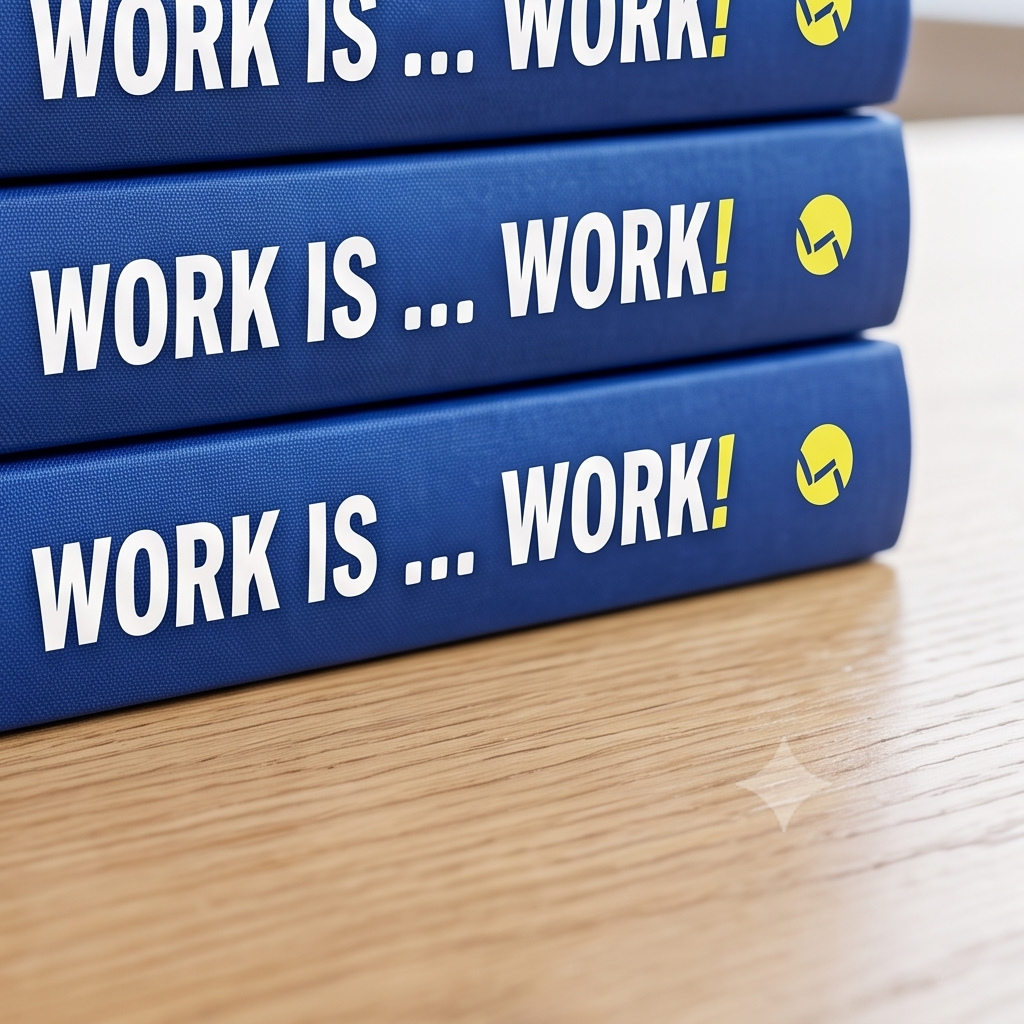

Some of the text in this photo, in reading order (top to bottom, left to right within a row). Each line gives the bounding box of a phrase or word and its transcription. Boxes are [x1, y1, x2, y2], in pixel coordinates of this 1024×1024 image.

[30, 246, 280, 375] WORK
[307, 236, 376, 342] IS
[501, 199, 734, 317] WORK!
[32, 509, 280, 651] WORK
[308, 495, 377, 603] IS
[501, 434, 735, 565] WORK!
